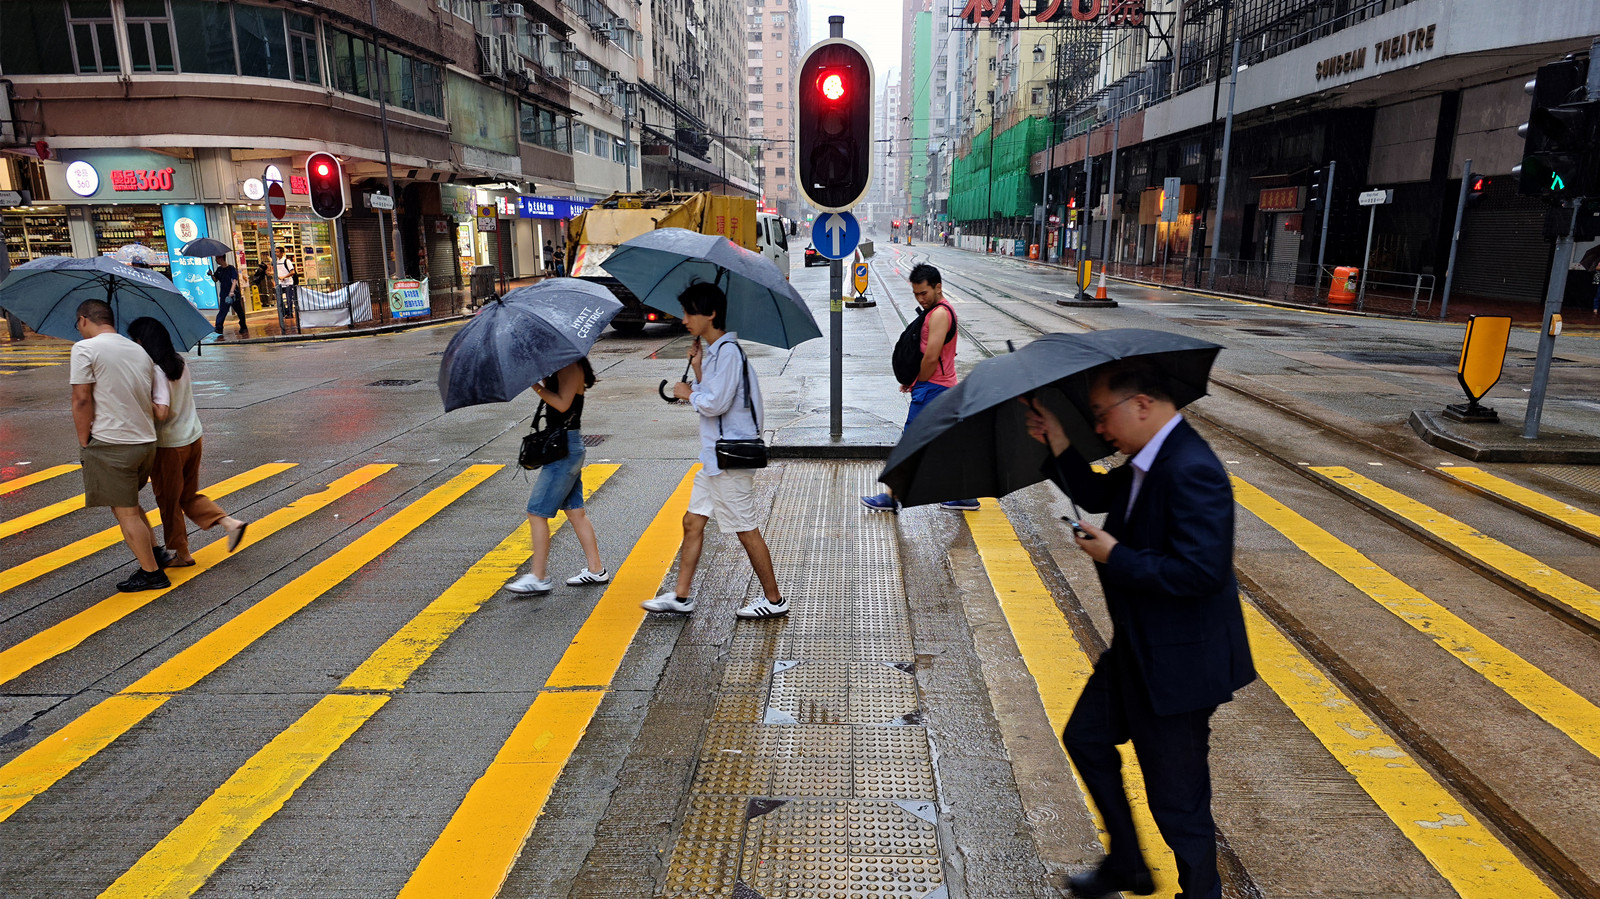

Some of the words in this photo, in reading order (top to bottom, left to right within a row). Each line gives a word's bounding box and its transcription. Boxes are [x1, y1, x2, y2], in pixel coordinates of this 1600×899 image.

[1315, 47, 1367, 80] SUNBEAM
[1375, 23, 1436, 64] THEATRE
[571, 306, 592, 330] HYATT
[577, 306, 605, 339] CENTRIC
